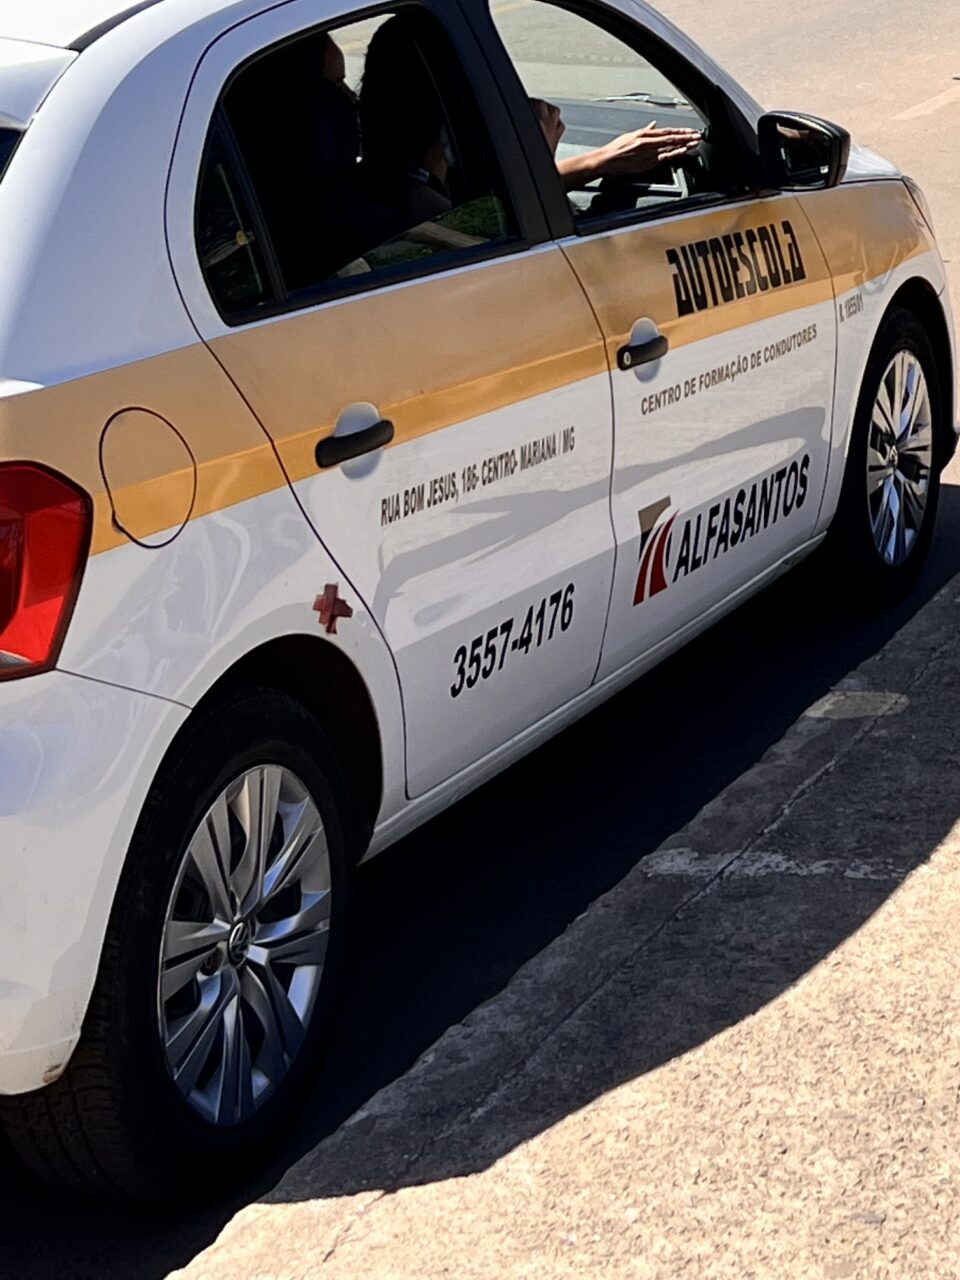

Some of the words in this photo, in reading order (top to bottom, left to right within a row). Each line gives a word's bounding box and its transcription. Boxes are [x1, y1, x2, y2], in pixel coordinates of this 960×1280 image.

[665, 220, 807, 318] AUTOESCOLA
[641, 383, 681, 415] CENTRO
[684, 377, 696, 399] DE
[699, 354, 749, 393] FORMAÇÃO
[750, 351, 762, 370] DE
[763, 323, 817, 364] CONDUTORES
[380, 493, 401, 526] RUA
[403, 483, 425, 517] BOM
[427, 472, 459, 508] JESUS,
[520, 433, 556, 471] MARIANA
[562, 426, 575, 454] MG
[672, 454, 811, 584] ALFASANTOS
[449, 582, 575, 699] 3557-4176
